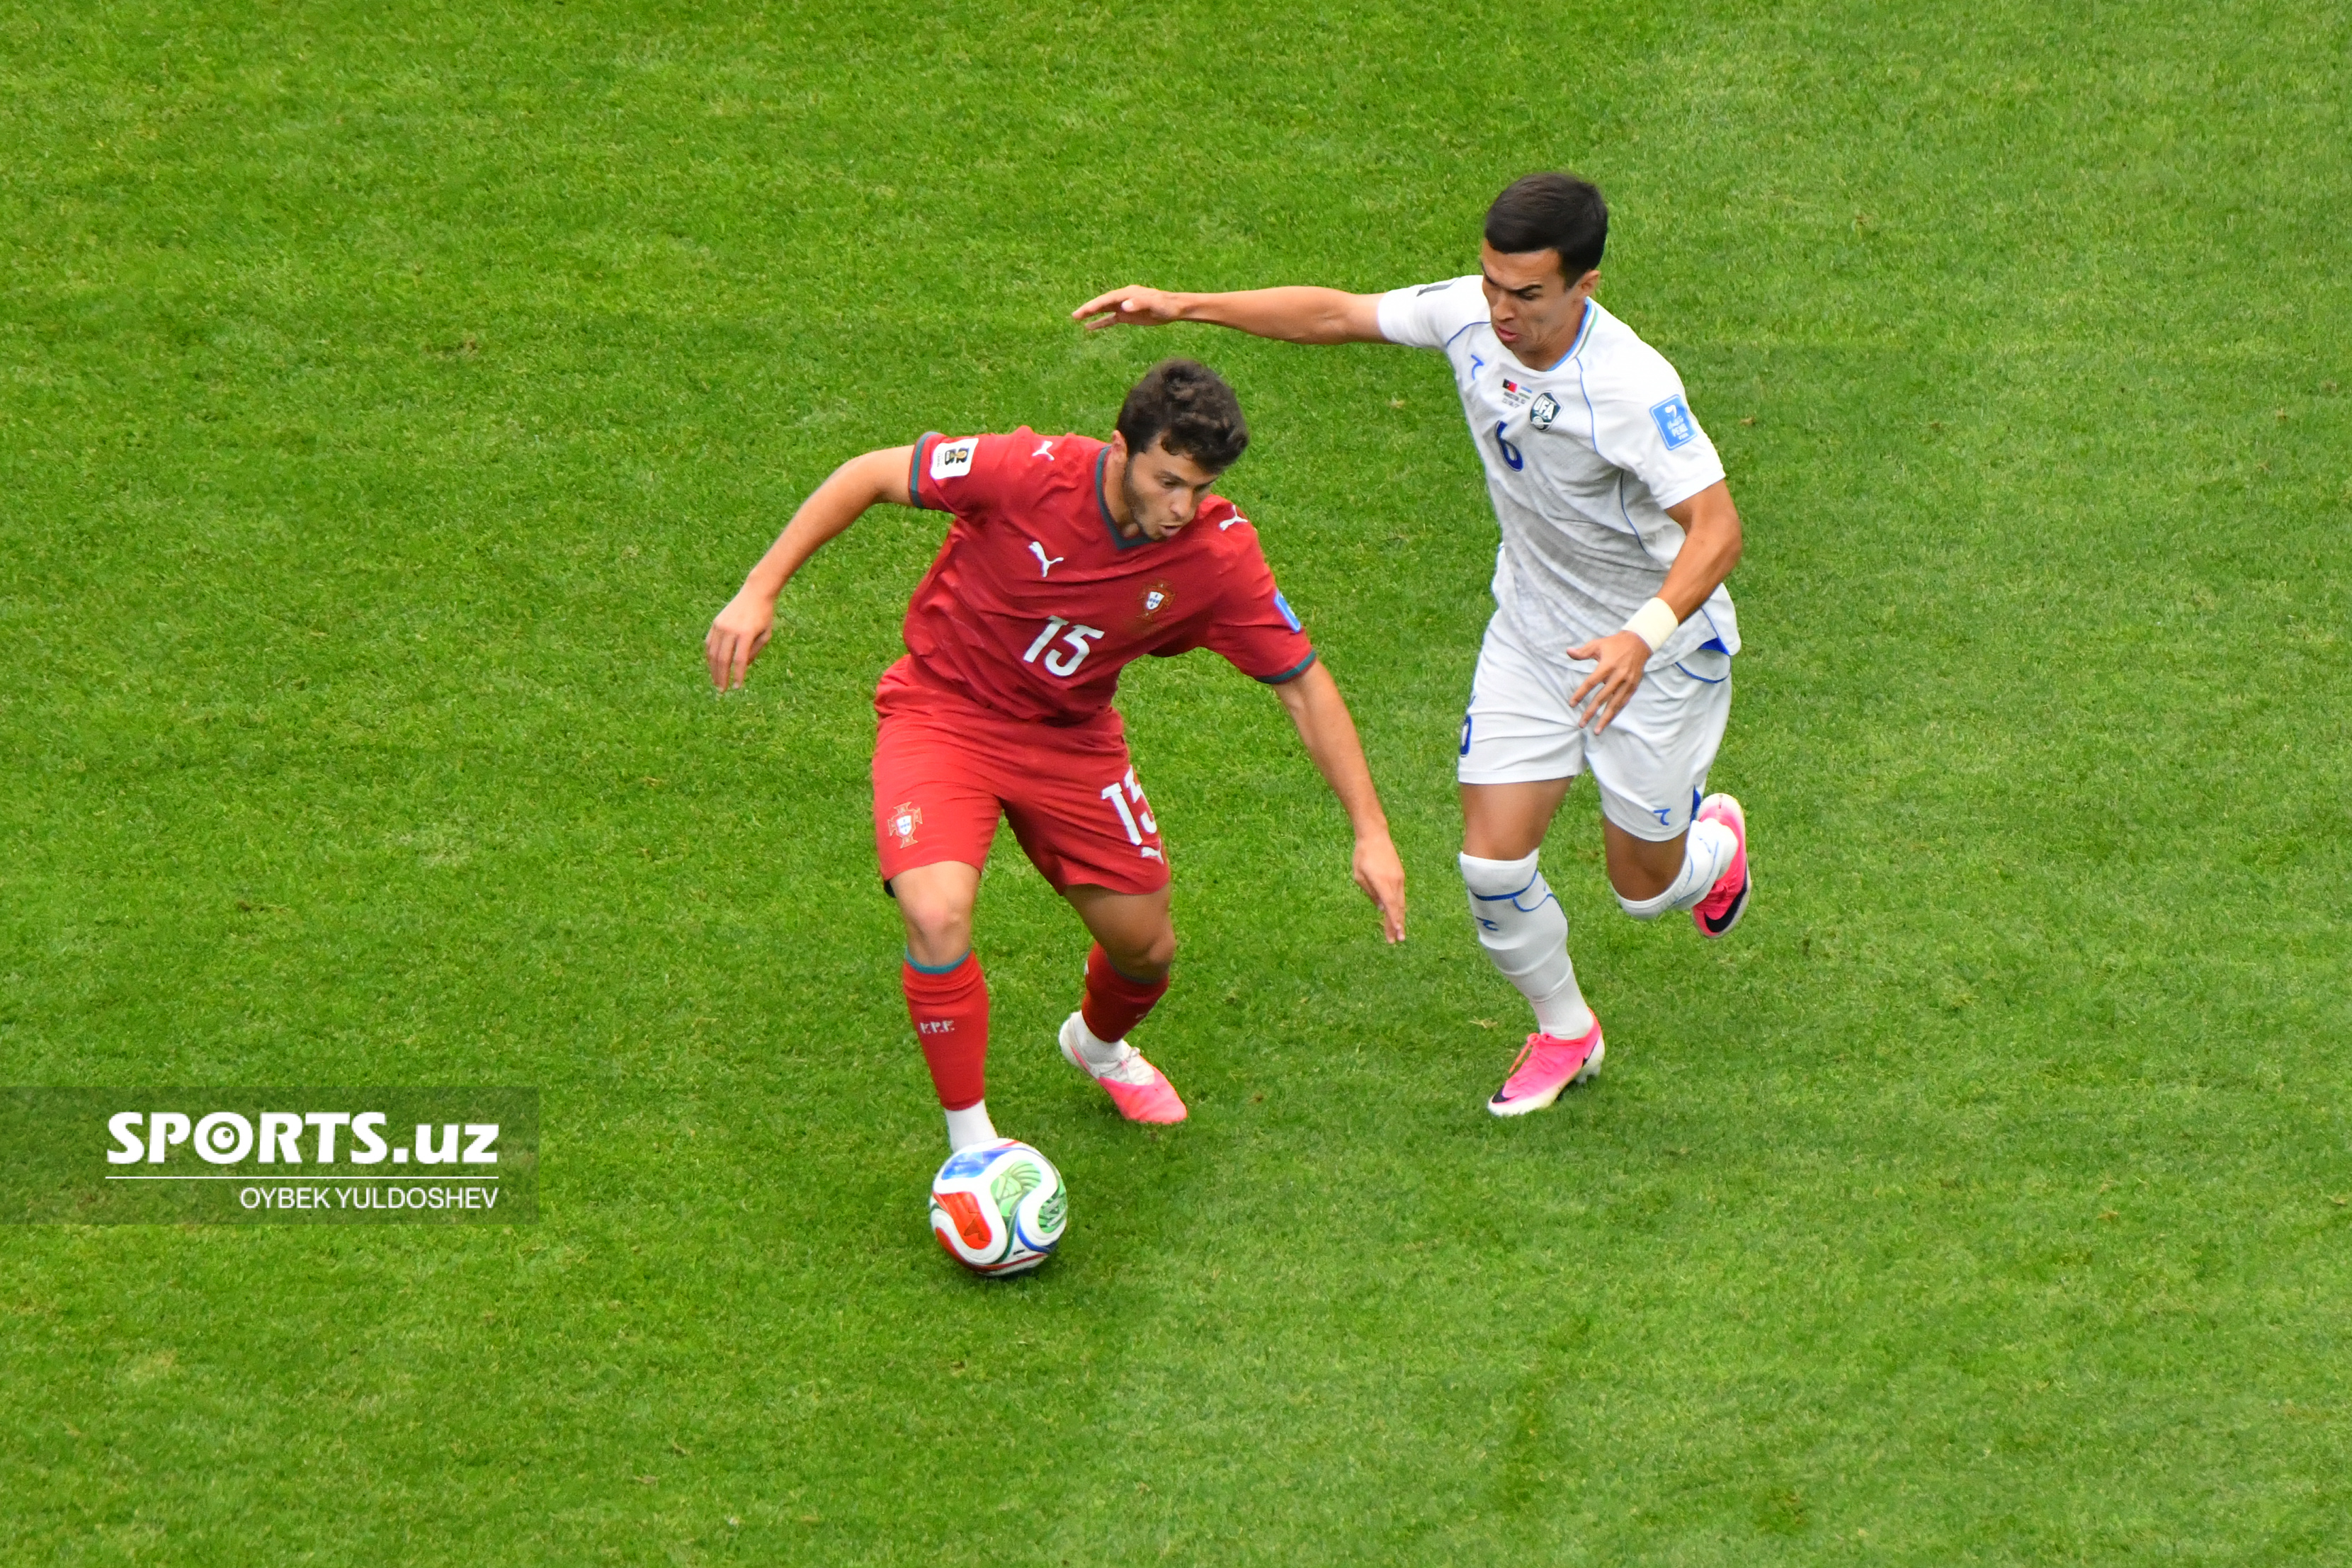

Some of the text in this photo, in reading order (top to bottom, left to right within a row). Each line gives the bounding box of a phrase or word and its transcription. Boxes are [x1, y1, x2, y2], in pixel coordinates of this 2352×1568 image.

[1533, 395, 1555, 420] UFA
[1494, 420, 1523, 472] 6
[1023, 615, 1105, 676] 15
